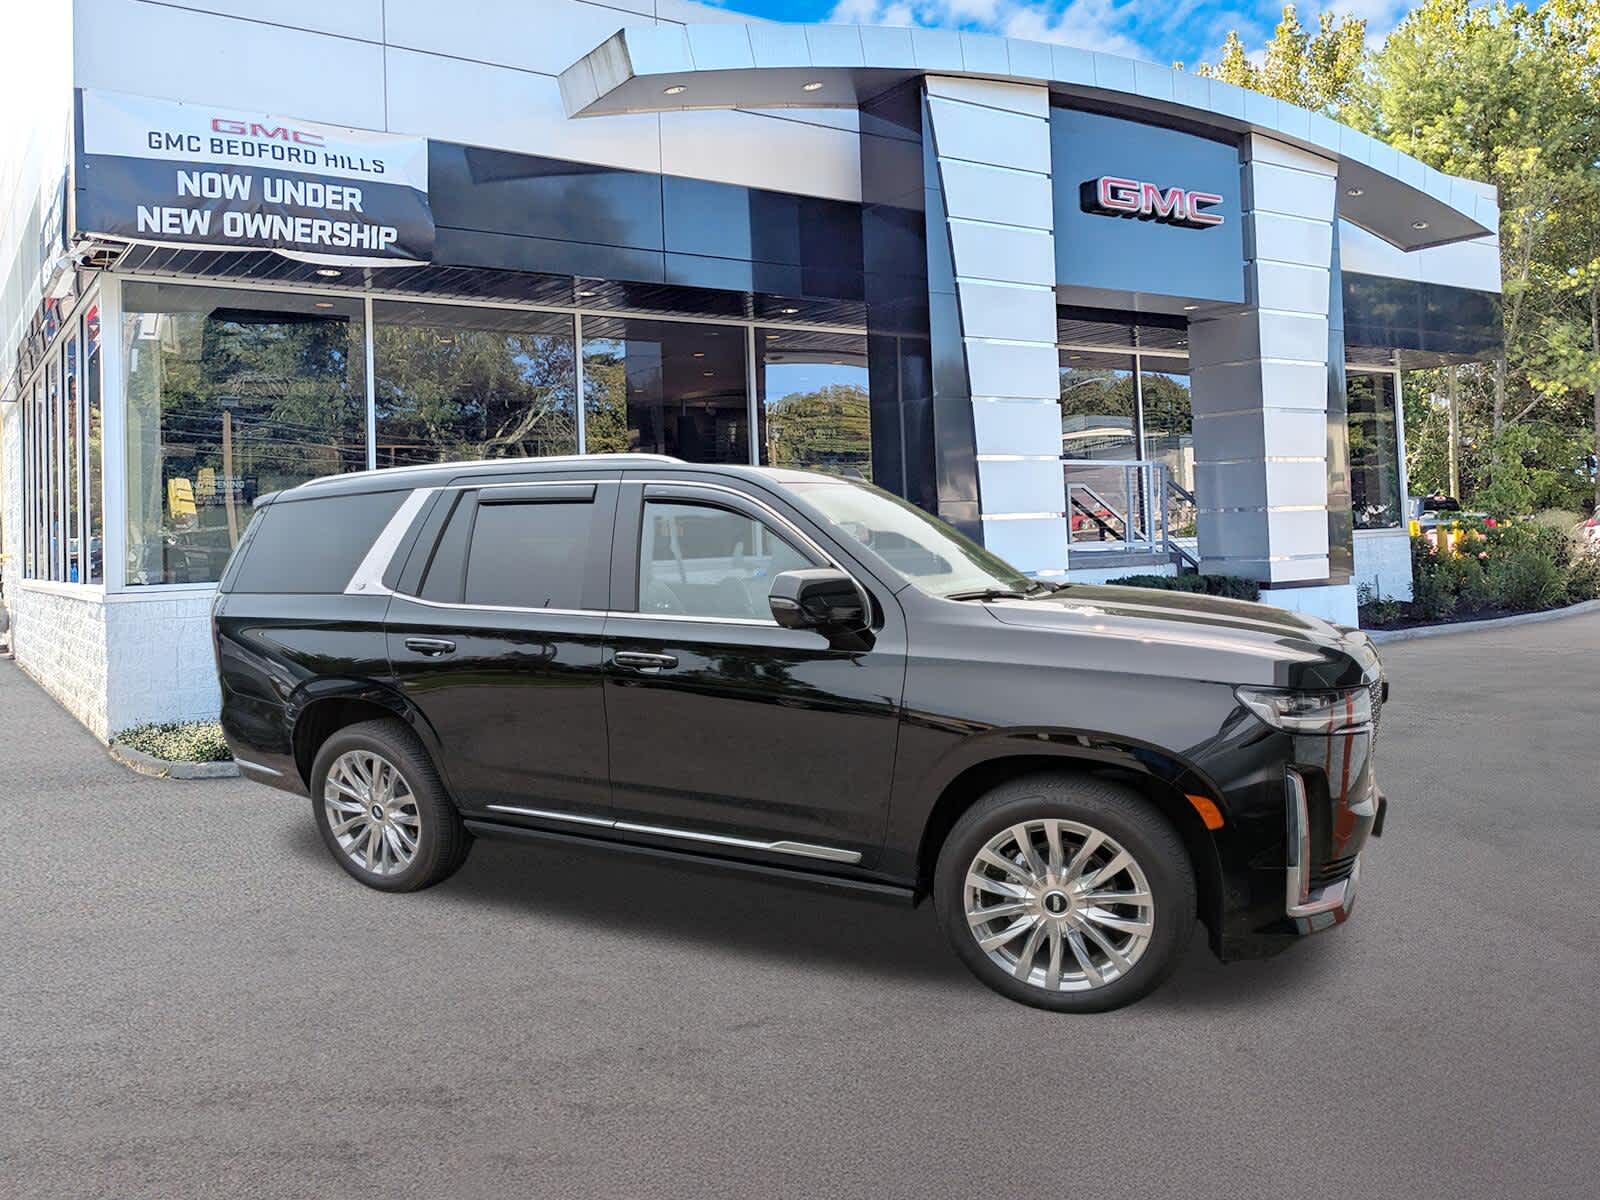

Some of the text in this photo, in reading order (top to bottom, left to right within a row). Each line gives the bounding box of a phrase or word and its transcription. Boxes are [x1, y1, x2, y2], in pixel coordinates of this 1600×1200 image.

[148, 131, 385, 174] GMC BEDFORD HILLS
[210, 118, 326, 147] GMC
[177, 169, 364, 213] NOW UNDER
[1098, 176, 1224, 224] GMC
[136, 205, 398, 251] NEW OWNERSHIP
